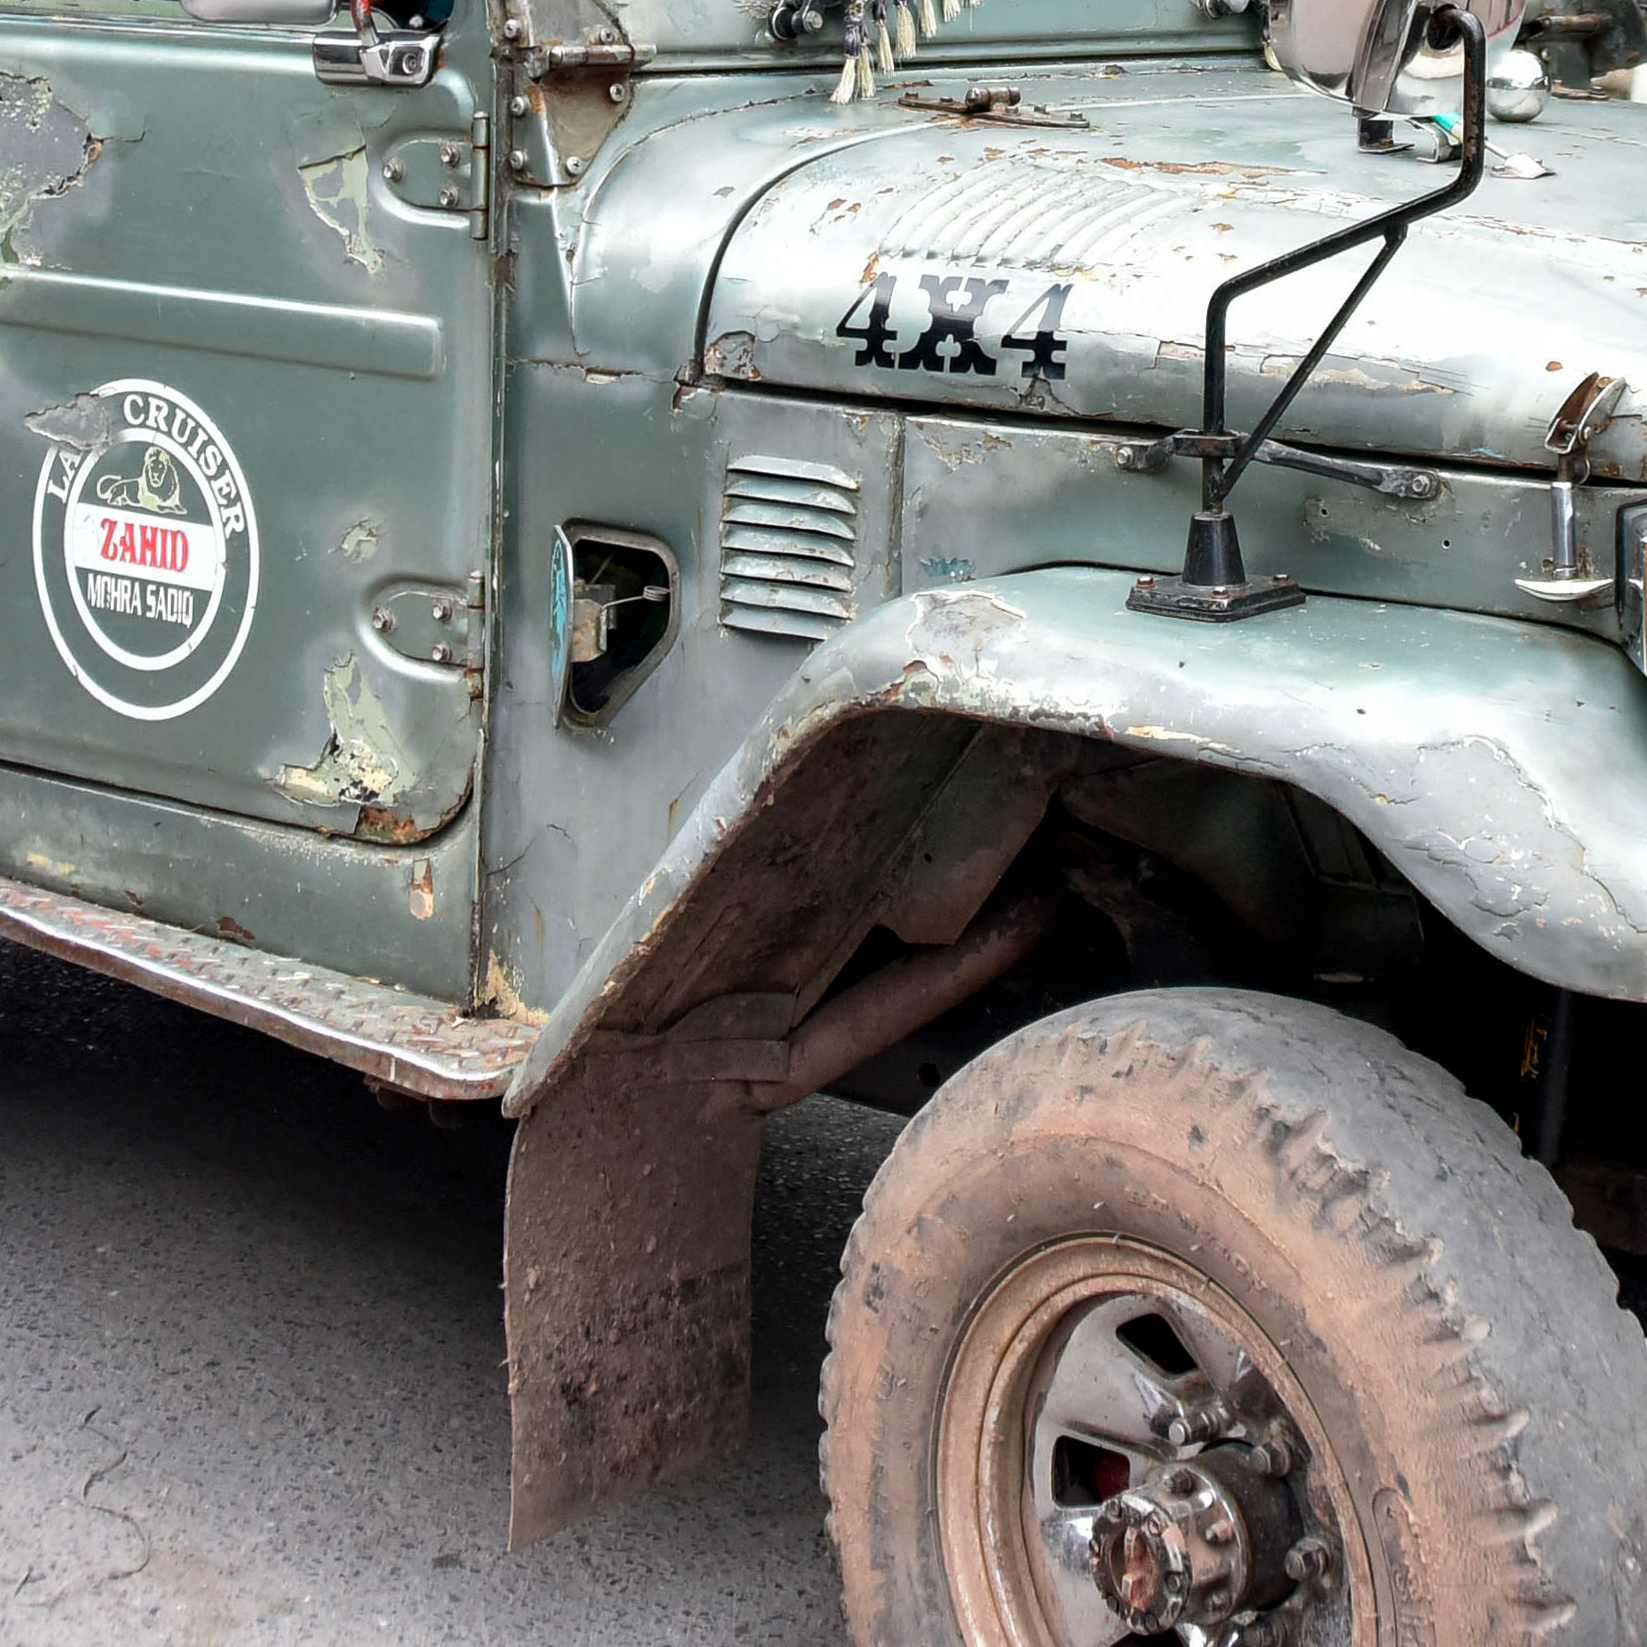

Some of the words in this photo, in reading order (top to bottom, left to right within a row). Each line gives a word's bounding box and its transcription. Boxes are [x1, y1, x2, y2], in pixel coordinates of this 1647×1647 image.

[123, 394, 246, 540] CRUISER
[99, 518, 190, 574] ZAHID
[145, 583, 194, 629] SADIQ
